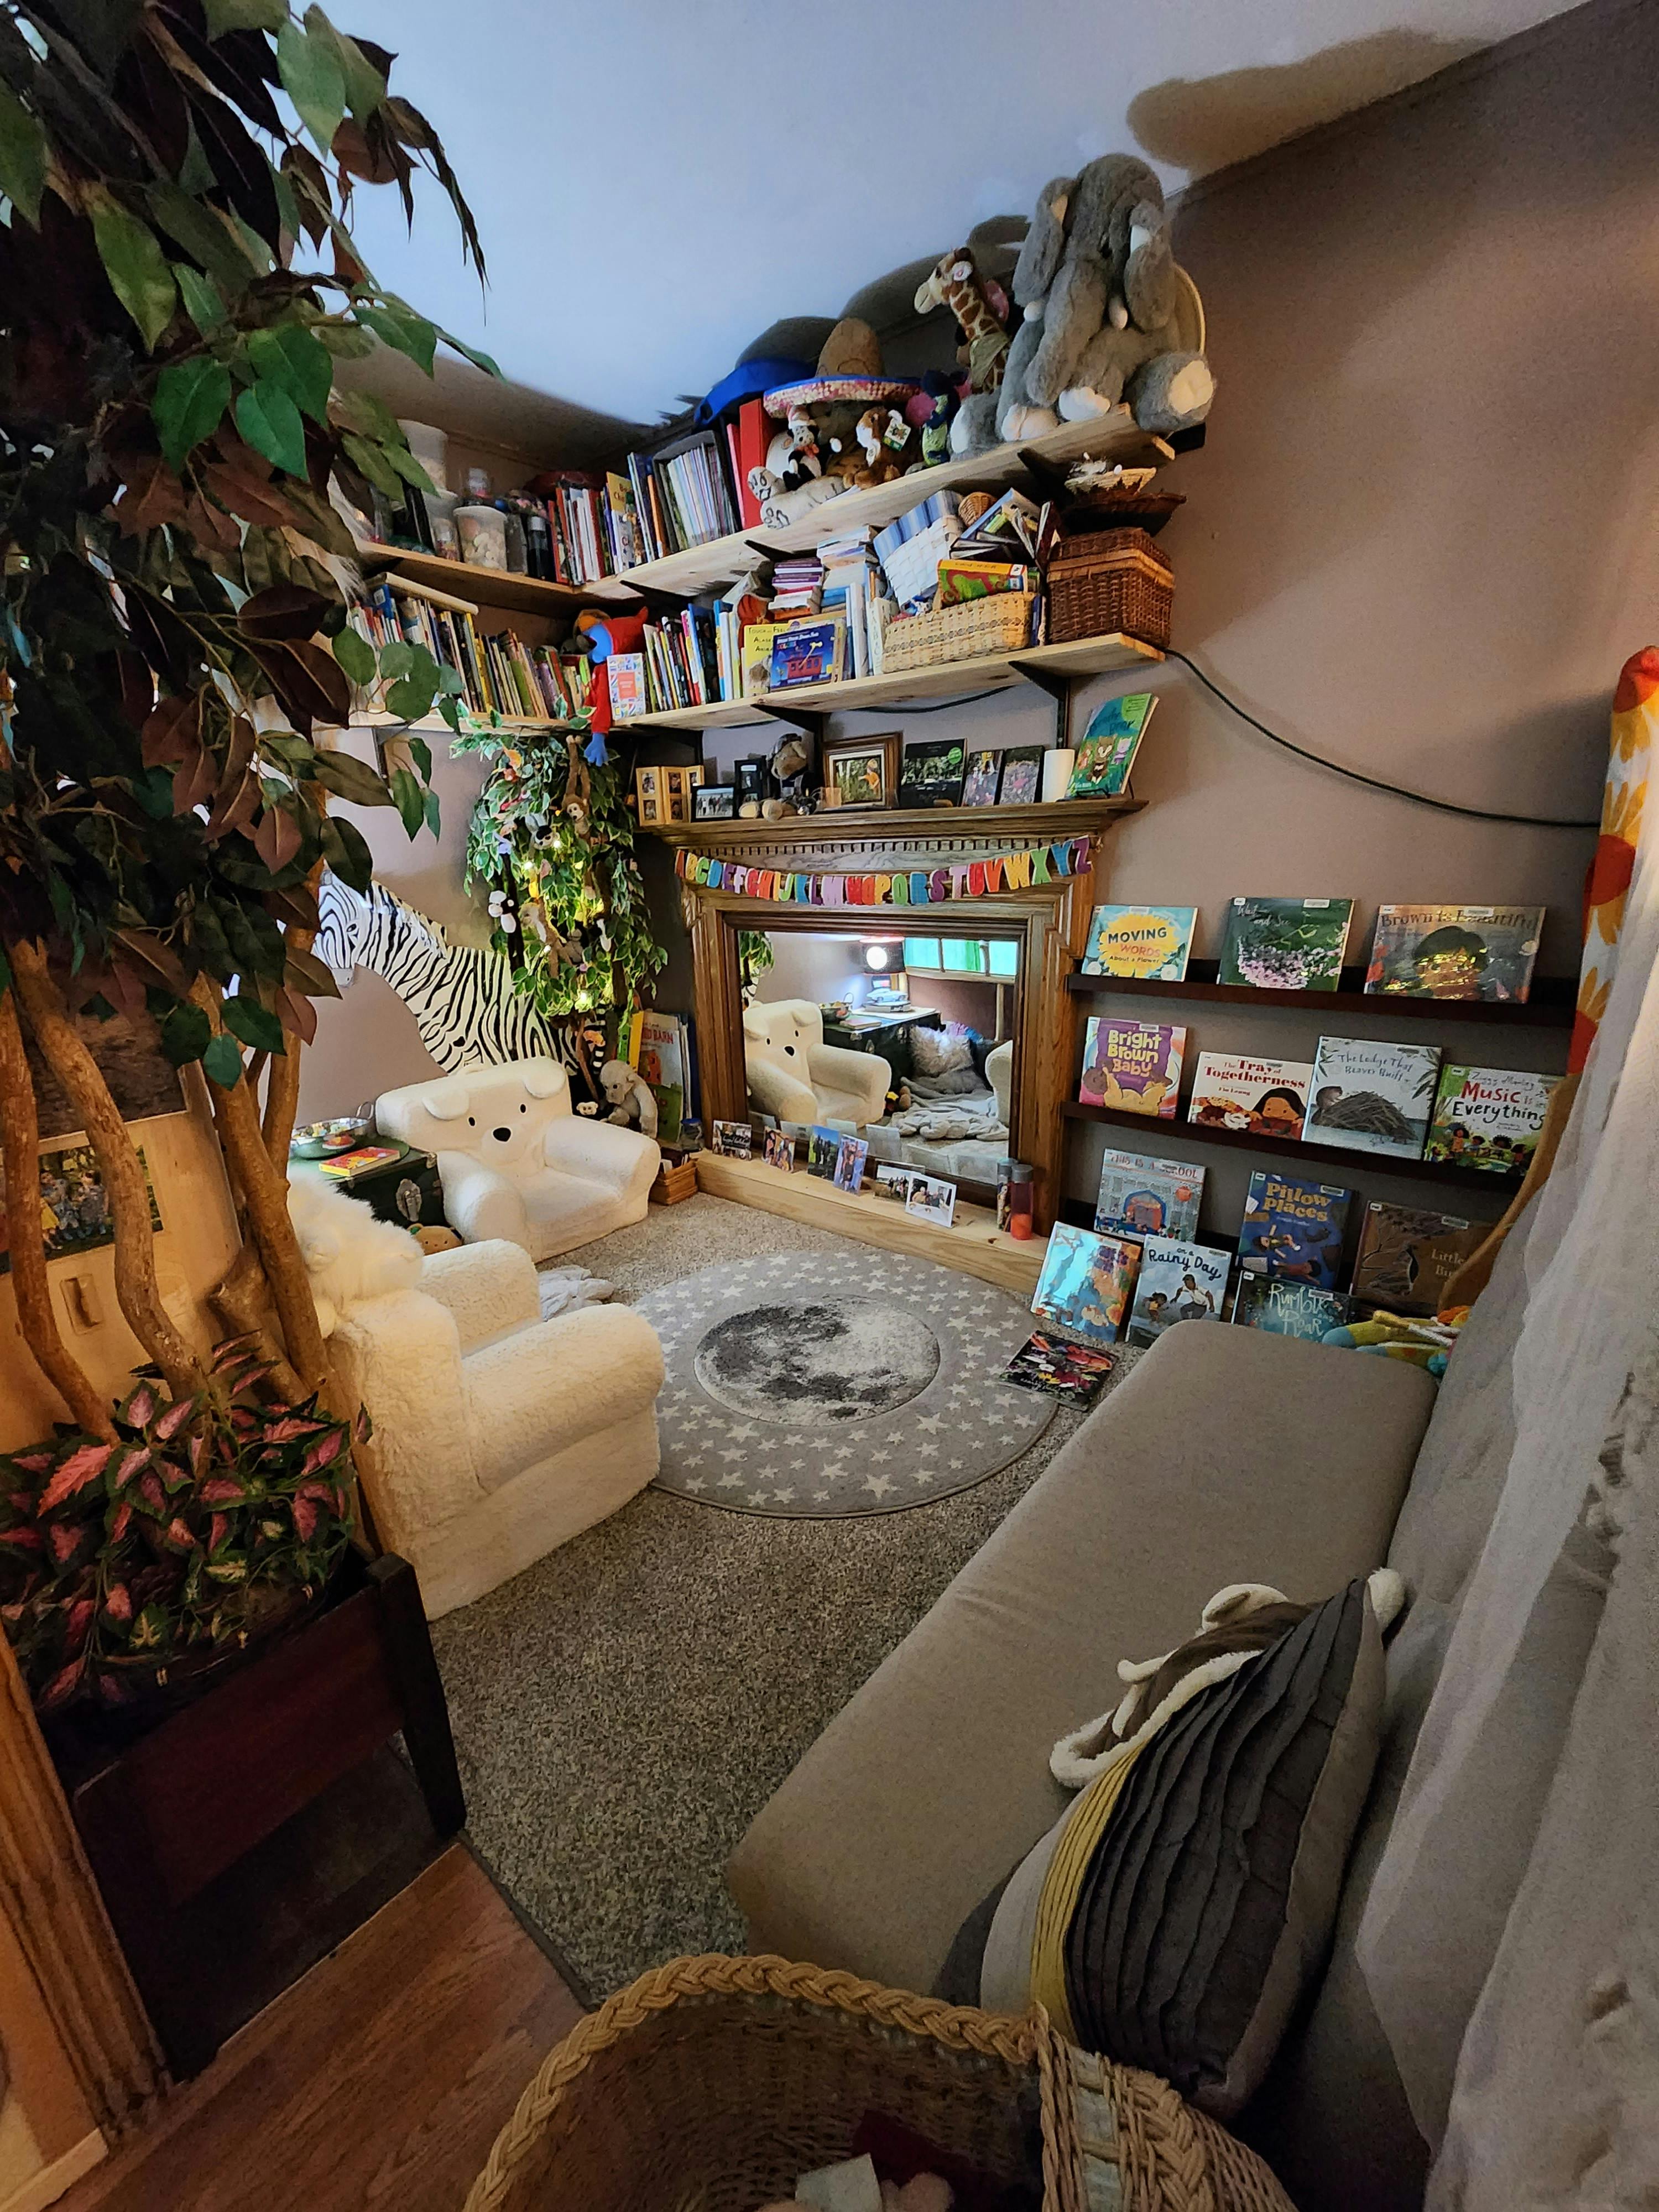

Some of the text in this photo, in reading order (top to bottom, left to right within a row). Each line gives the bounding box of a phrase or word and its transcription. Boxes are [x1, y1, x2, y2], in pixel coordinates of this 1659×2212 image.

[1380, 911, 1432, 927] Brown
[1108, 927, 1167, 944] MOVING
[1120, 945, 1161, 958] WORDS
[1108, 1030, 1162, 1050] Bright
[1107, 1044, 1159, 1063] Brown
[1337, 1052, 1357, 1063] The
[1391, 1057, 1413, 1072] That
[1112, 1058, 1152, 1077] Baby
[1204, 1066, 1306, 1089] Togetherness
[1238, 1060, 1272, 1075] Tray
[1460, 1080, 1522, 1103] Music
[1452, 1101, 1546, 1131] Everything
[1266, 1182, 1332, 1207] Pillow
[1262, 1196, 1328, 1222] Places
[1148, 1249, 1223, 1281] Rainy Day
[1431, 1248, 1465, 1265] Little
